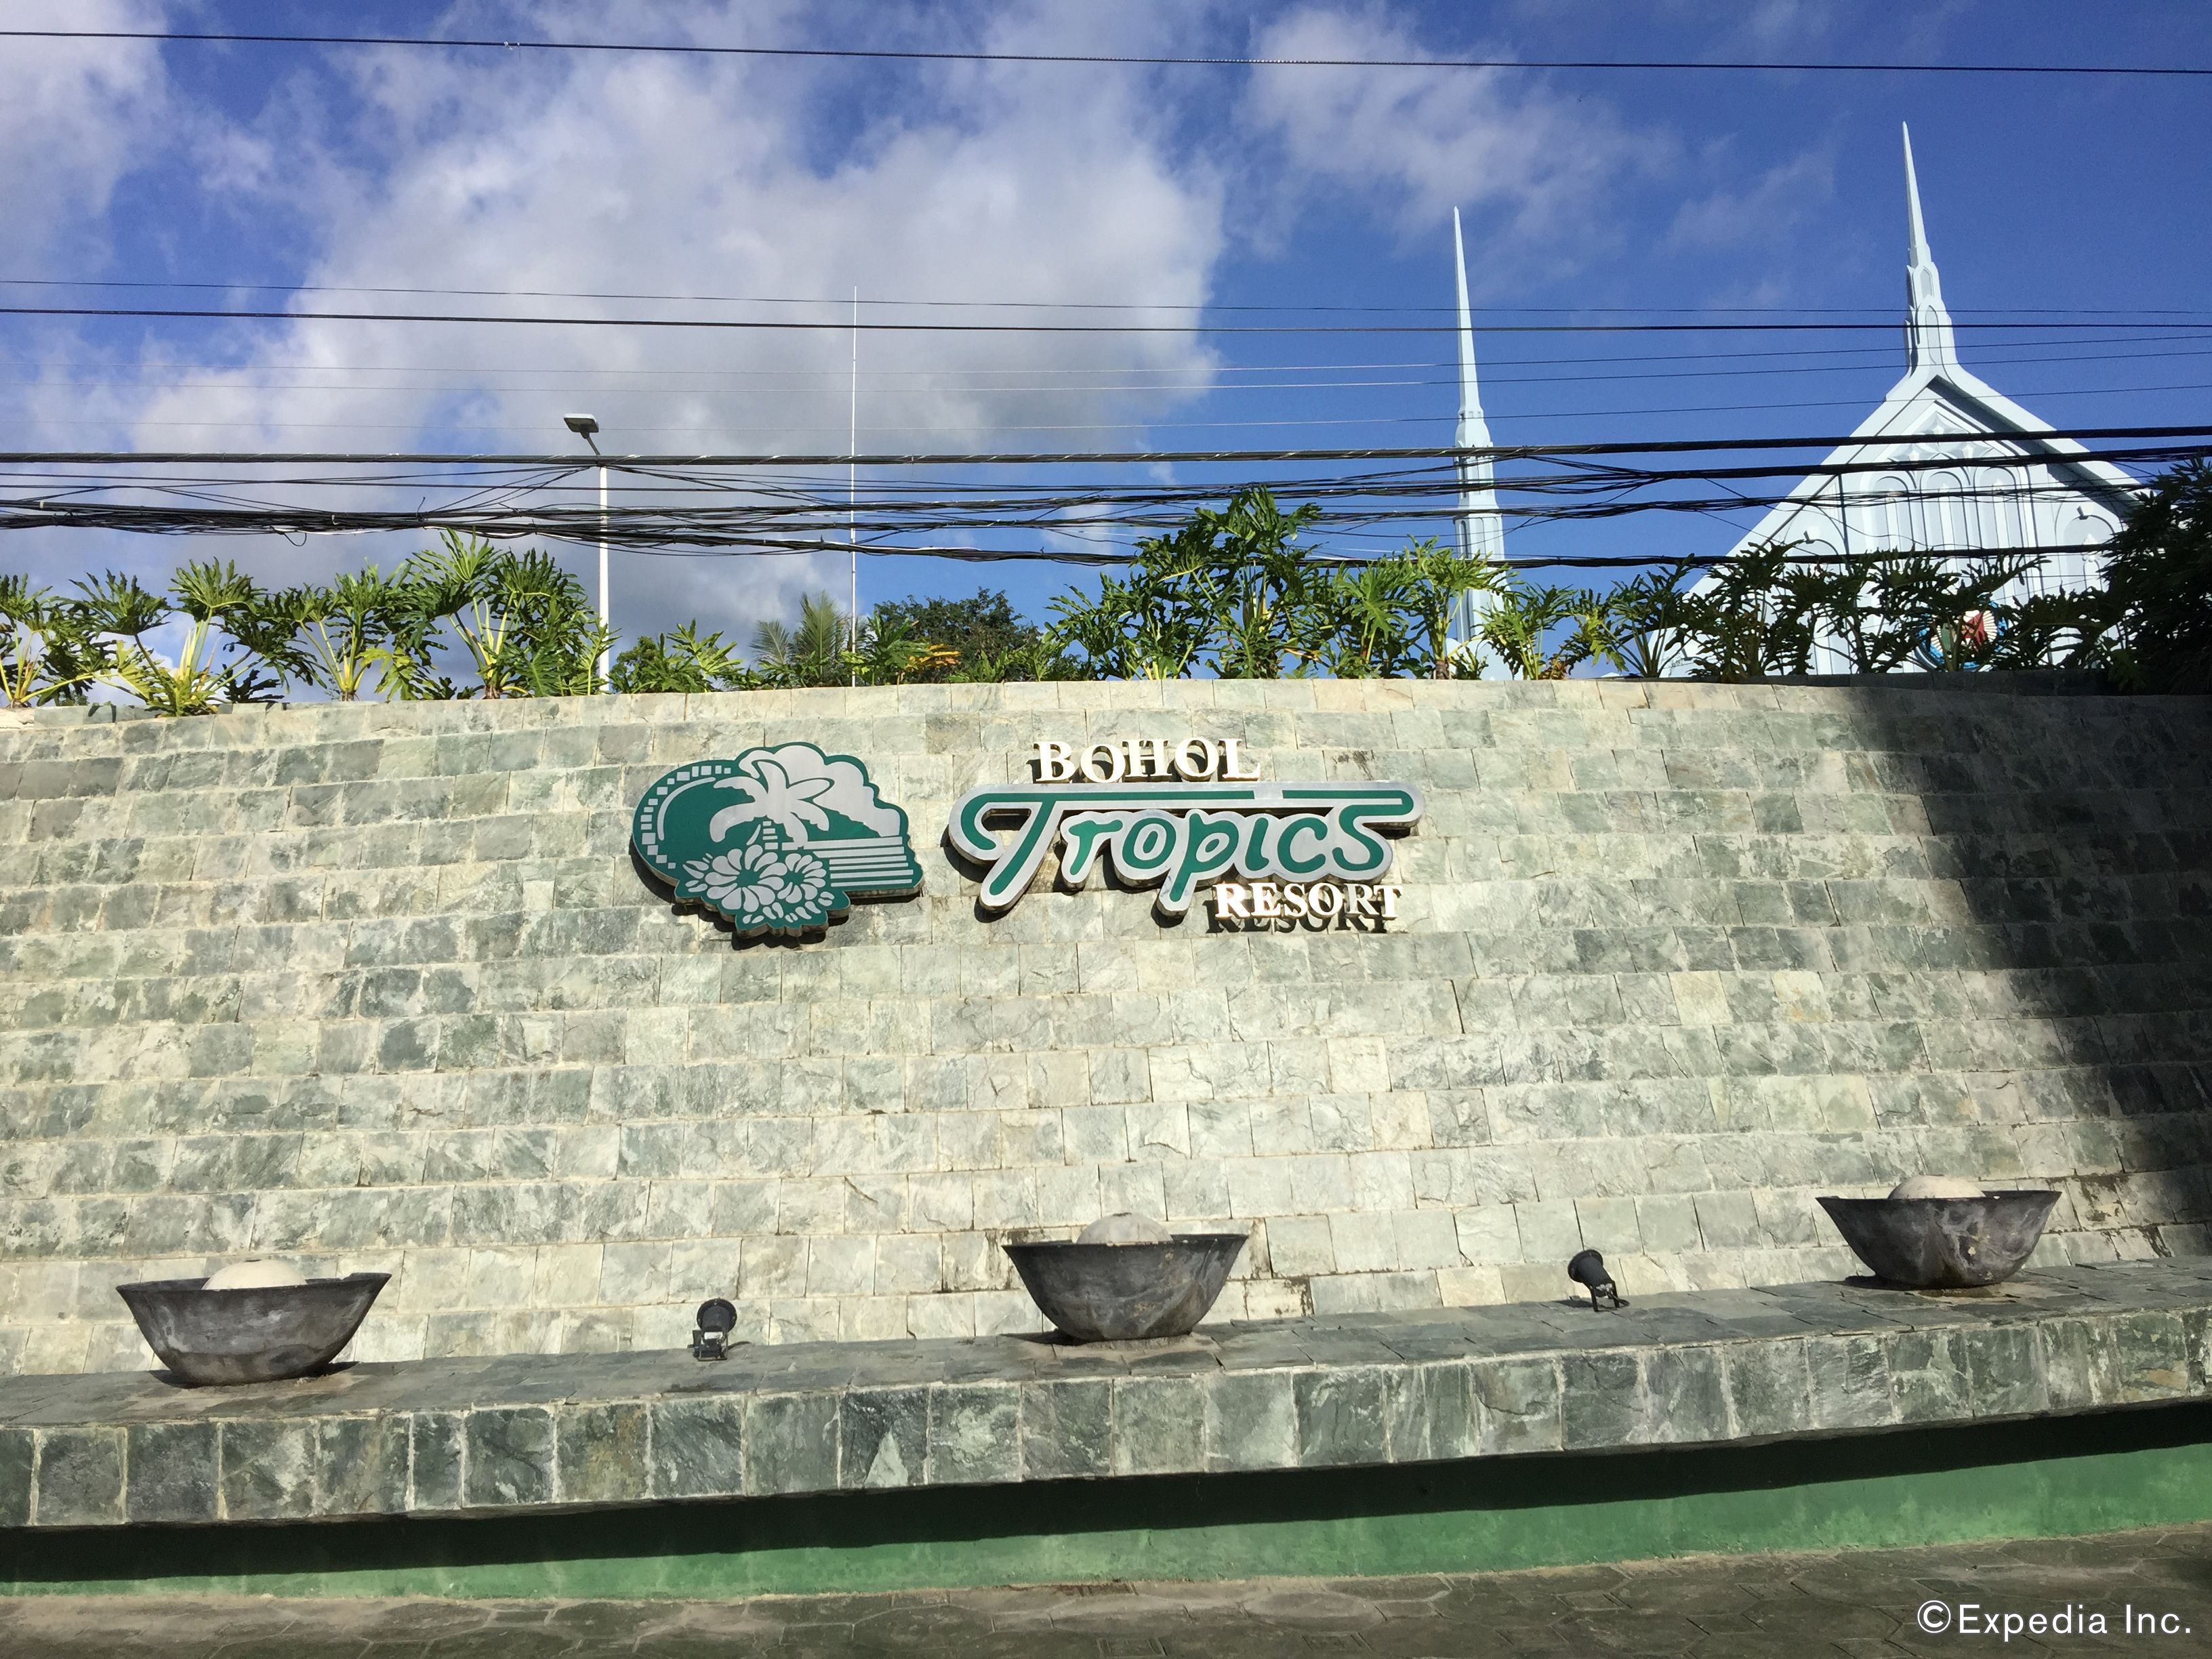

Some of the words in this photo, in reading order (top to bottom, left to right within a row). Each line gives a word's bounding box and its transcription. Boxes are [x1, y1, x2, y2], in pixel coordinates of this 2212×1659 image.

[1035, 737, 1261, 782] BOHOL
[960, 790, 1414, 902] Tropics
[1214, 882, 1404, 920] RESORT
